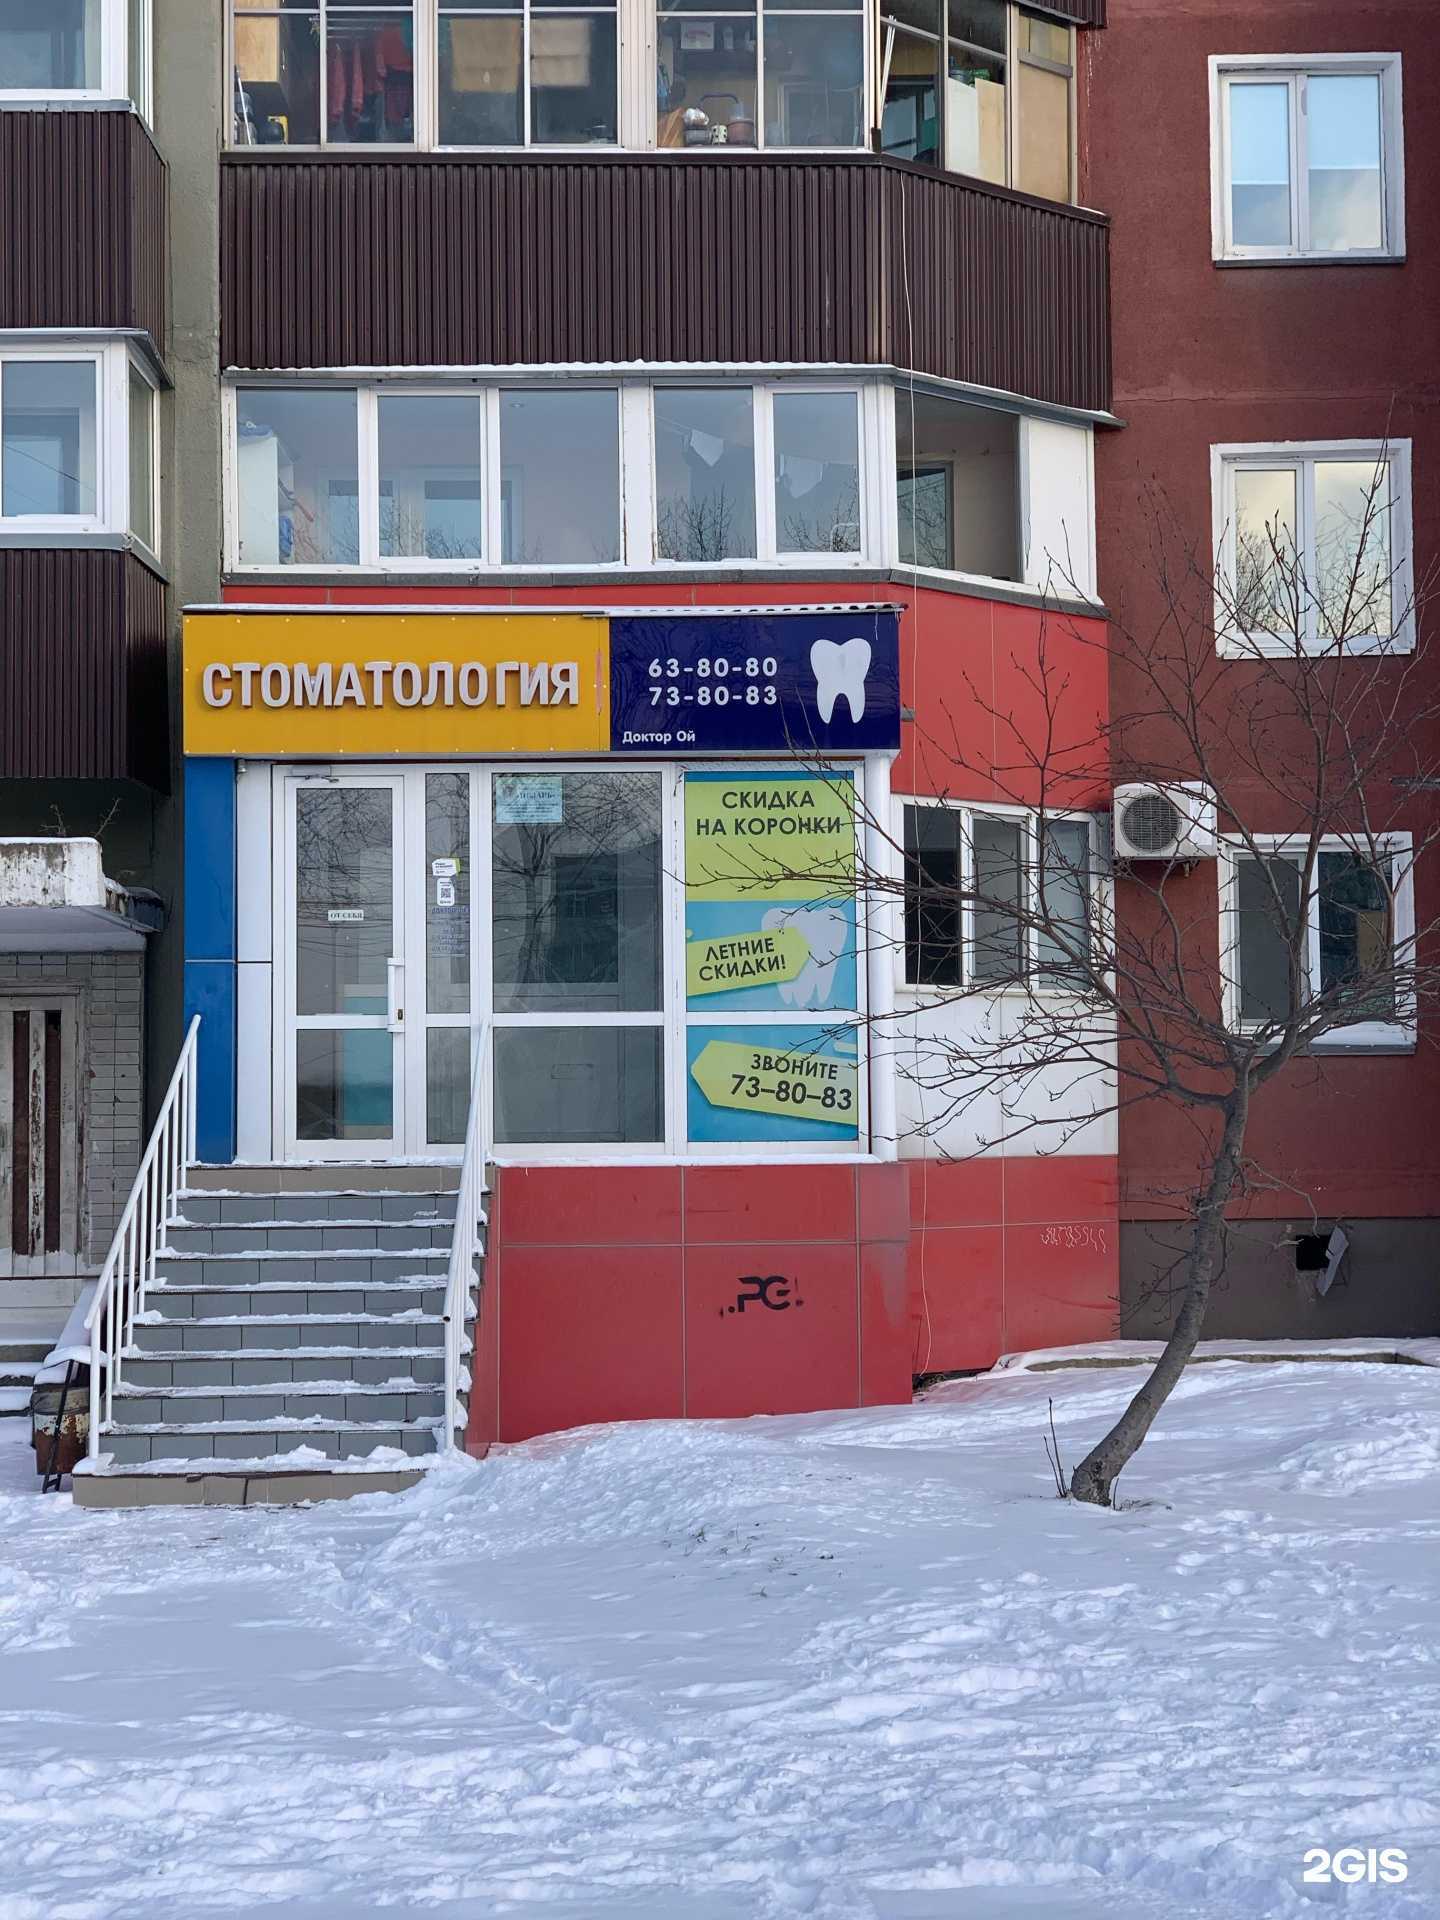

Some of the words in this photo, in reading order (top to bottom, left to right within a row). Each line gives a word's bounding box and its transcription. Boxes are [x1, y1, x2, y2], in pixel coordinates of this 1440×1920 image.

[648, 657, 778, 678] 63-80-80
[203, 661, 580, 707] СТОМАТОЛОГИЯ
[648, 685, 777, 706] 73-80-83
[622, 731, 672, 744] Доктор
[676, 730, 696, 742] Ой
[721, 790, 815, 810] СКИДКА
[696, 818, 727, 836] НА
[734, 816, 841, 836] КОРОНКИ
[705, 937, 775, 962] ЛЕТНИЕ
[698, 953, 787, 982] СКИДКИ!
[750, 1053, 838, 1080] ЗВОНИТЕ
[730, 1073, 852, 1111] 73-80-83
